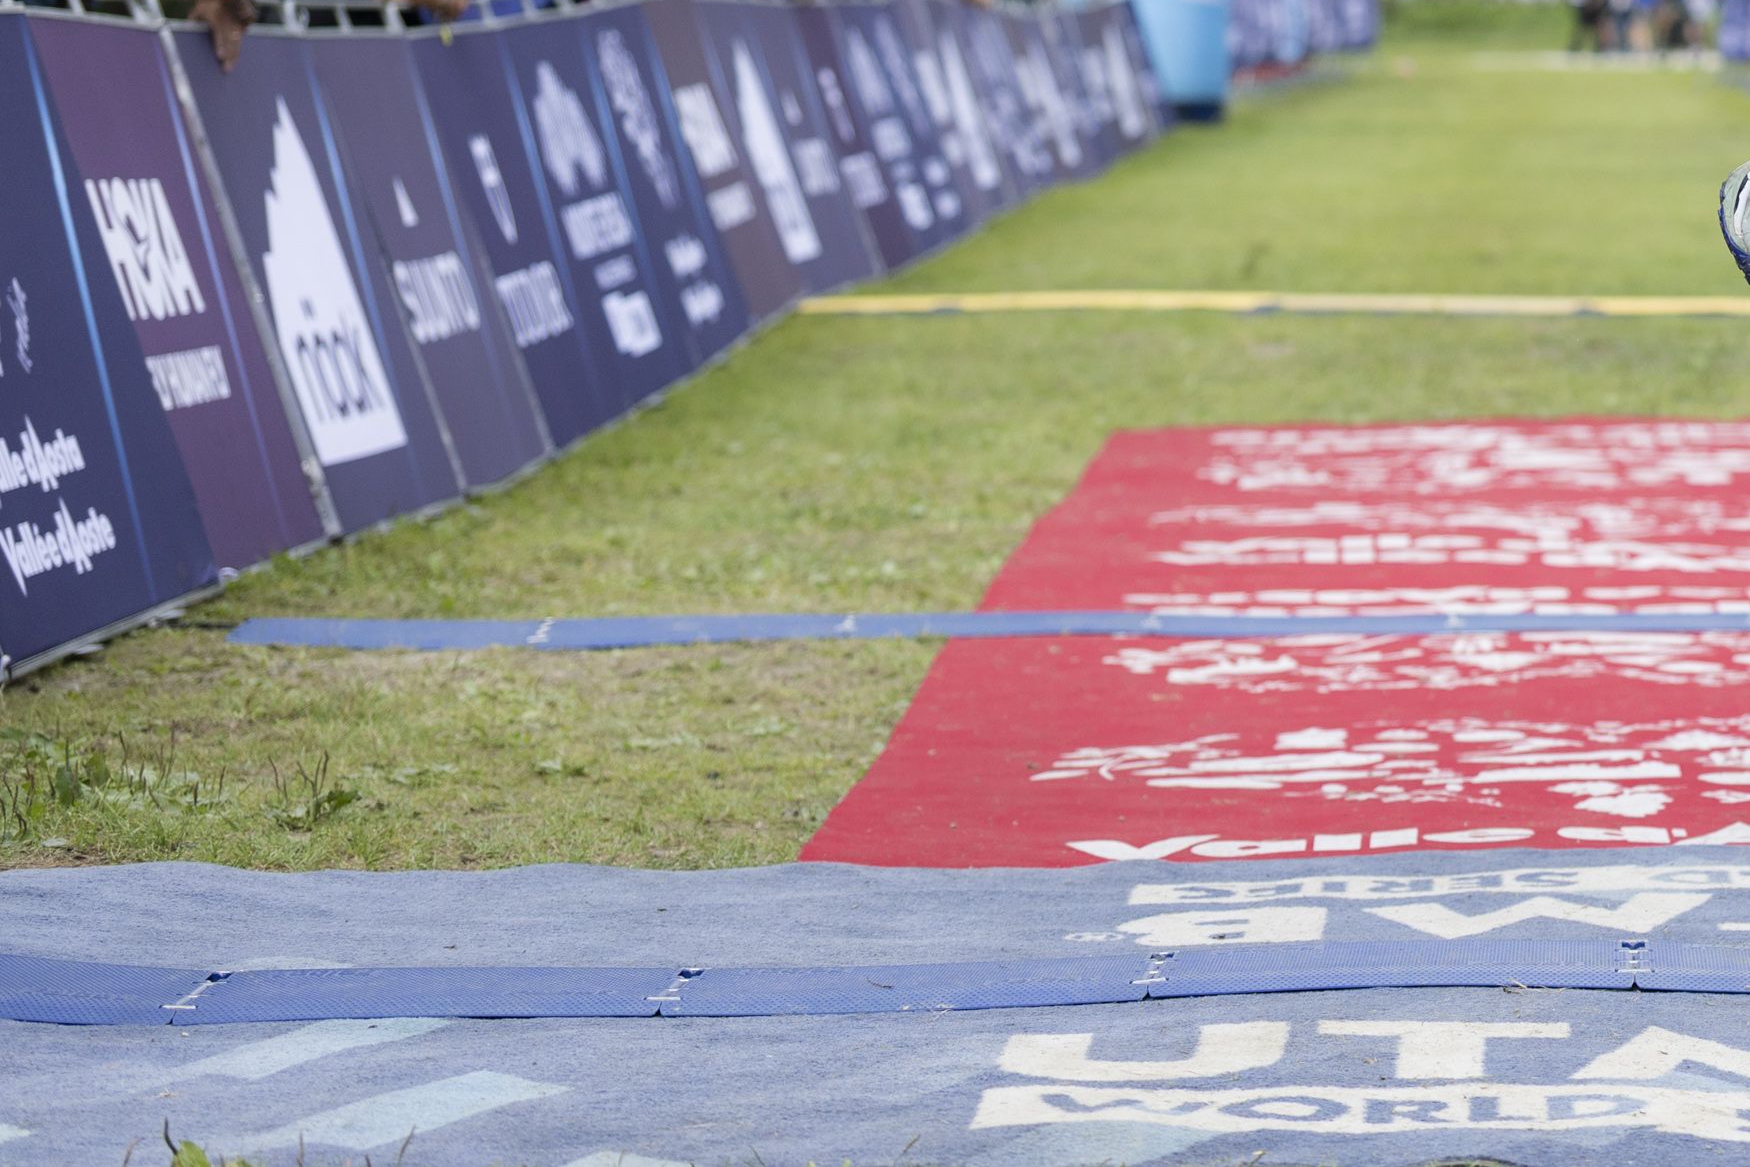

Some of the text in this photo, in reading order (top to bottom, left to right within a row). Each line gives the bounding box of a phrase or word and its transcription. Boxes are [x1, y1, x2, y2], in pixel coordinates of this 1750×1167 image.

[84, 177, 206, 322] HOKA
[1064, 827, 1534, 860] Valle
[1171, 871, 1579, 900] SERIES
[1040, 1092, 1642, 1125] WORLD
